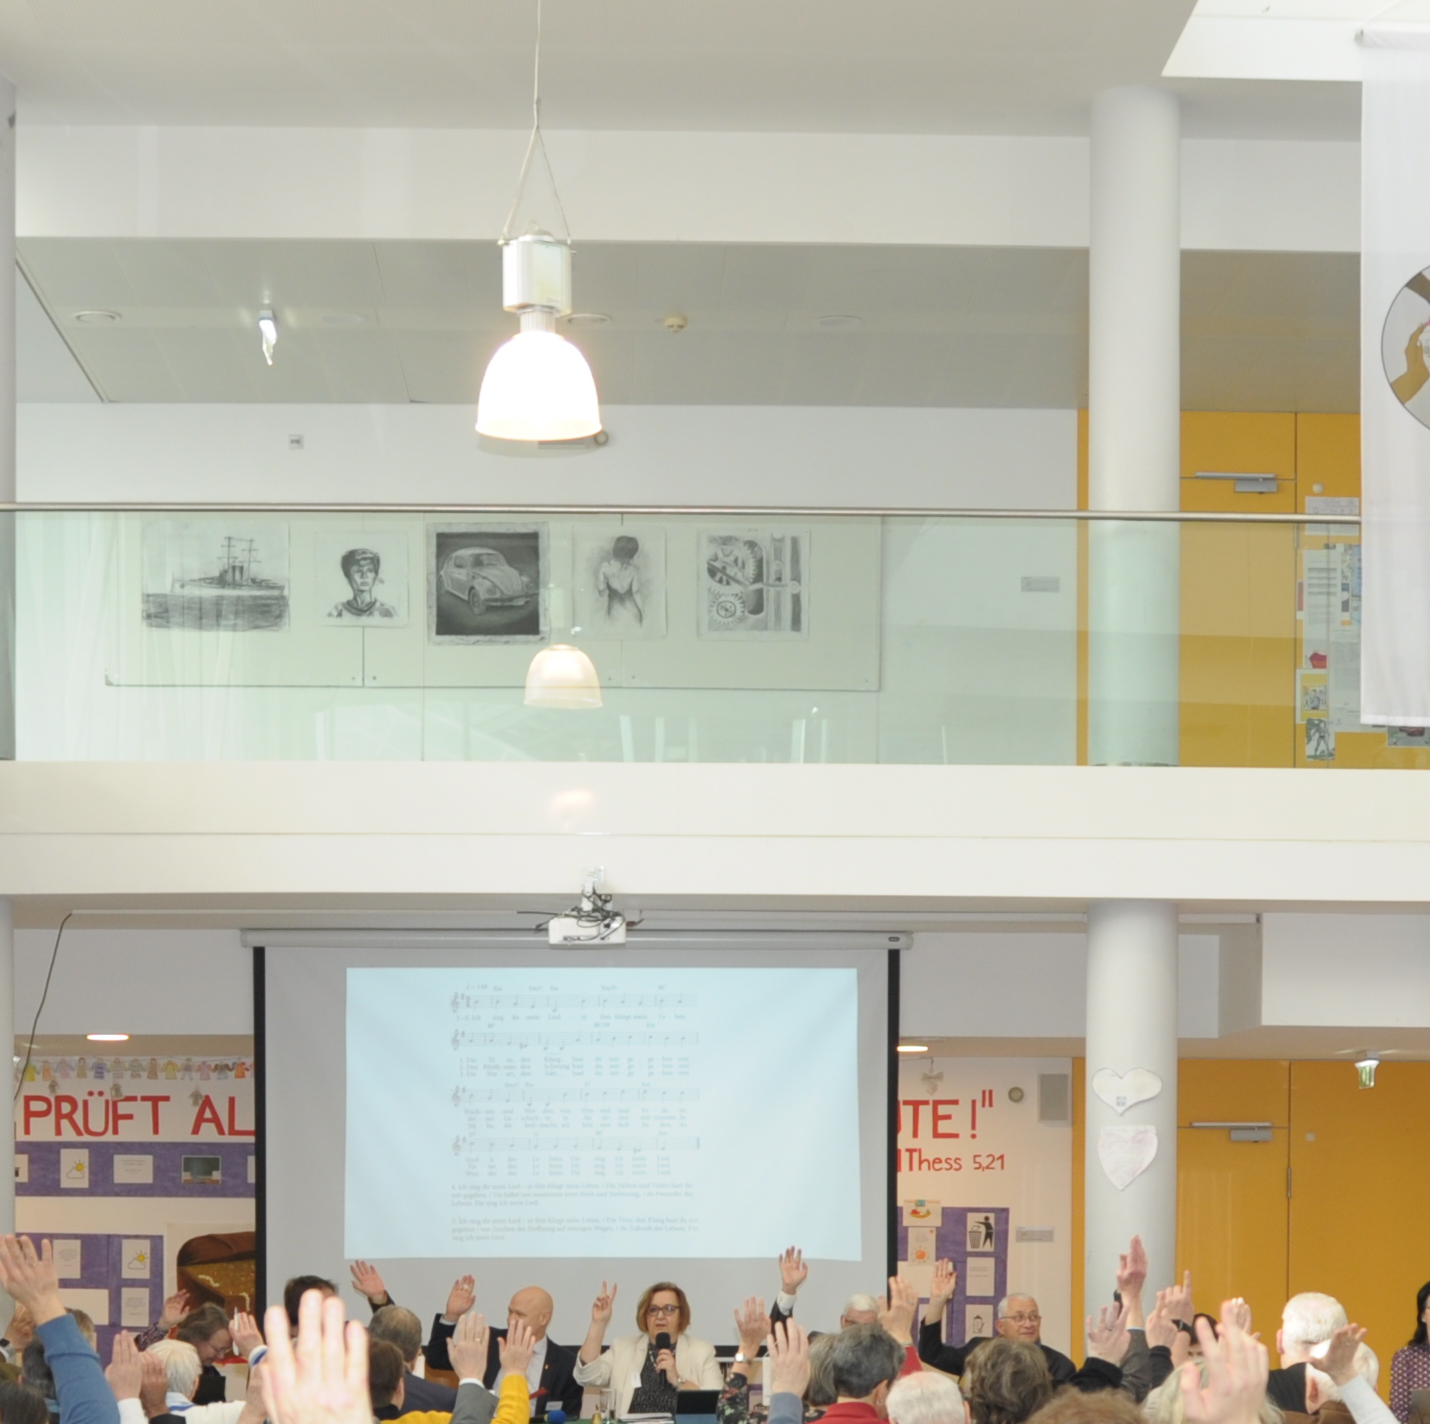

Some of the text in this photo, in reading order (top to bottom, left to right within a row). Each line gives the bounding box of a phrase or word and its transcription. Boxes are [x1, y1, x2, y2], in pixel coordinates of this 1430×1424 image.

[23, 1091, 171, 1137] PRÜFT
[904, 1148, 963, 1172] Thess
[972, 1153, 1006, 1172] 5,21
